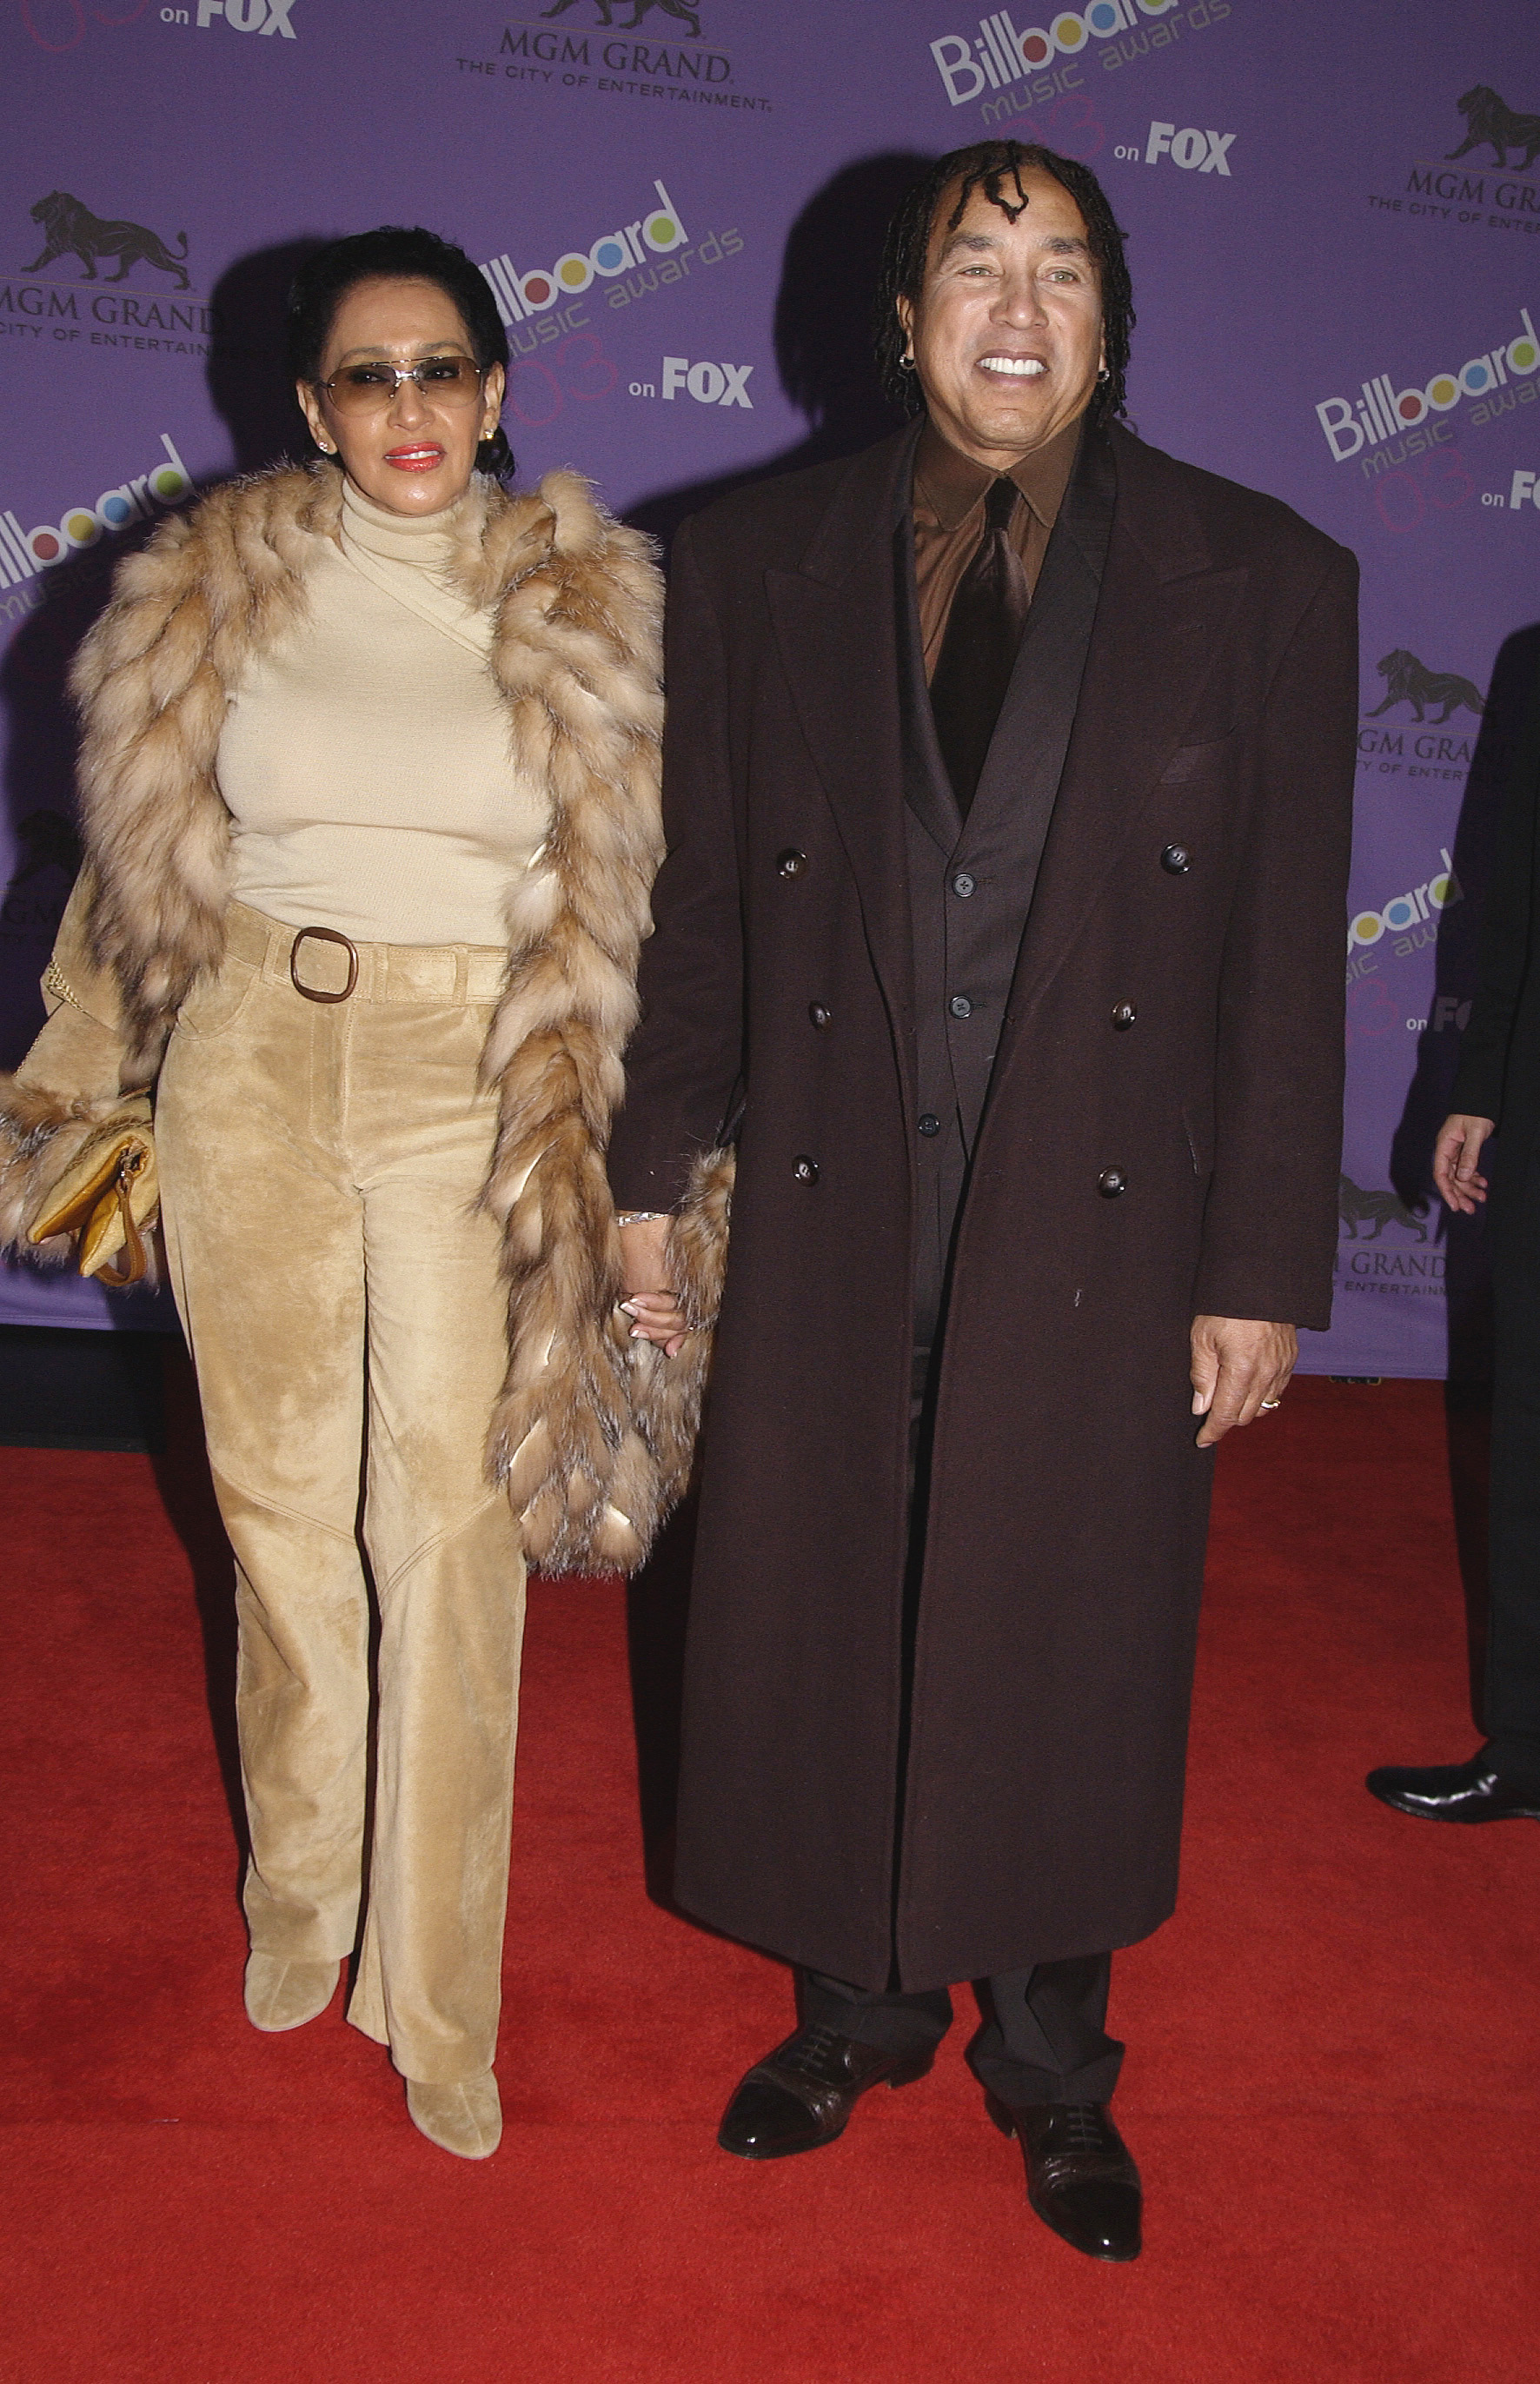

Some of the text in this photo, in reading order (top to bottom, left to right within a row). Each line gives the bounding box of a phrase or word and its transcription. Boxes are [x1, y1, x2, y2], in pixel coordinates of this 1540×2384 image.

[160, 0, 297, 39] on FOX
[500, 27, 591, 66] MGM
[455, 57, 497, 76] THE
[504, 64, 554, 83] CITY
[561, 72, 591, 89] OF
[1114, 120, 1238, 177] on FOX
[1367, 195, 1404, 212] THE
[1408, 202, 1451, 220] CITY
[1457, 209, 1482, 224] OF
[1406, 169, 1540, 214] MGM GR
[478, 179, 689, 328] llboard
[53, 327, 80, 343] OF
[628, 355, 754, 409] on FOX
[1314, 307, 1540, 463] Billboard
[1468, 375, 1540, 426] awa
[1481, 492, 1504, 508] on
[1378, 762, 1403, 774] OF
[1405, 1017, 1429, 1031] on
